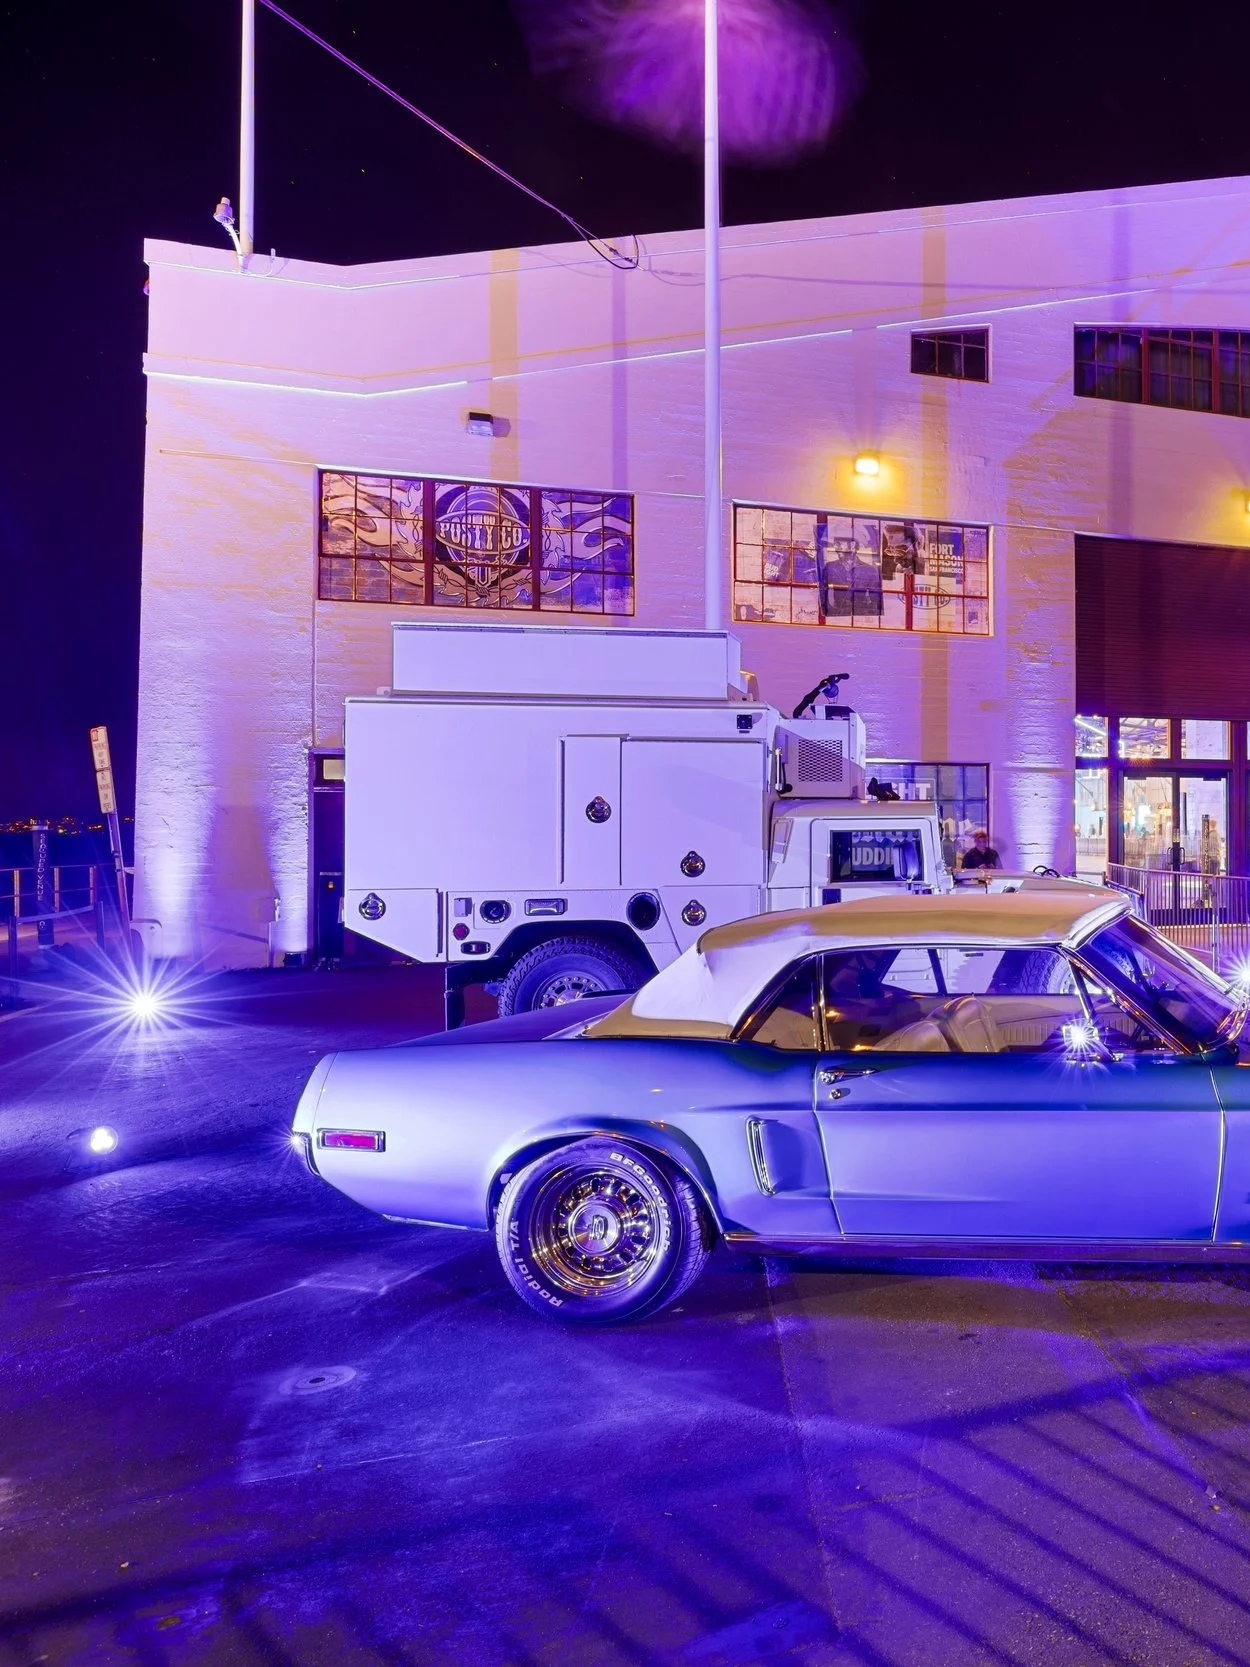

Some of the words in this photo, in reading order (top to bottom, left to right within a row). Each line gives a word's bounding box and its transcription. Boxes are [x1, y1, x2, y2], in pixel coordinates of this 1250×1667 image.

[930, 543, 954, 555] FORT
[930, 554, 963, 567] MASON
[609, 1152, 672, 1251] BFGoodrich
[508, 1220, 522, 1252] T/A
[514, 1257, 564, 1307] Radial
